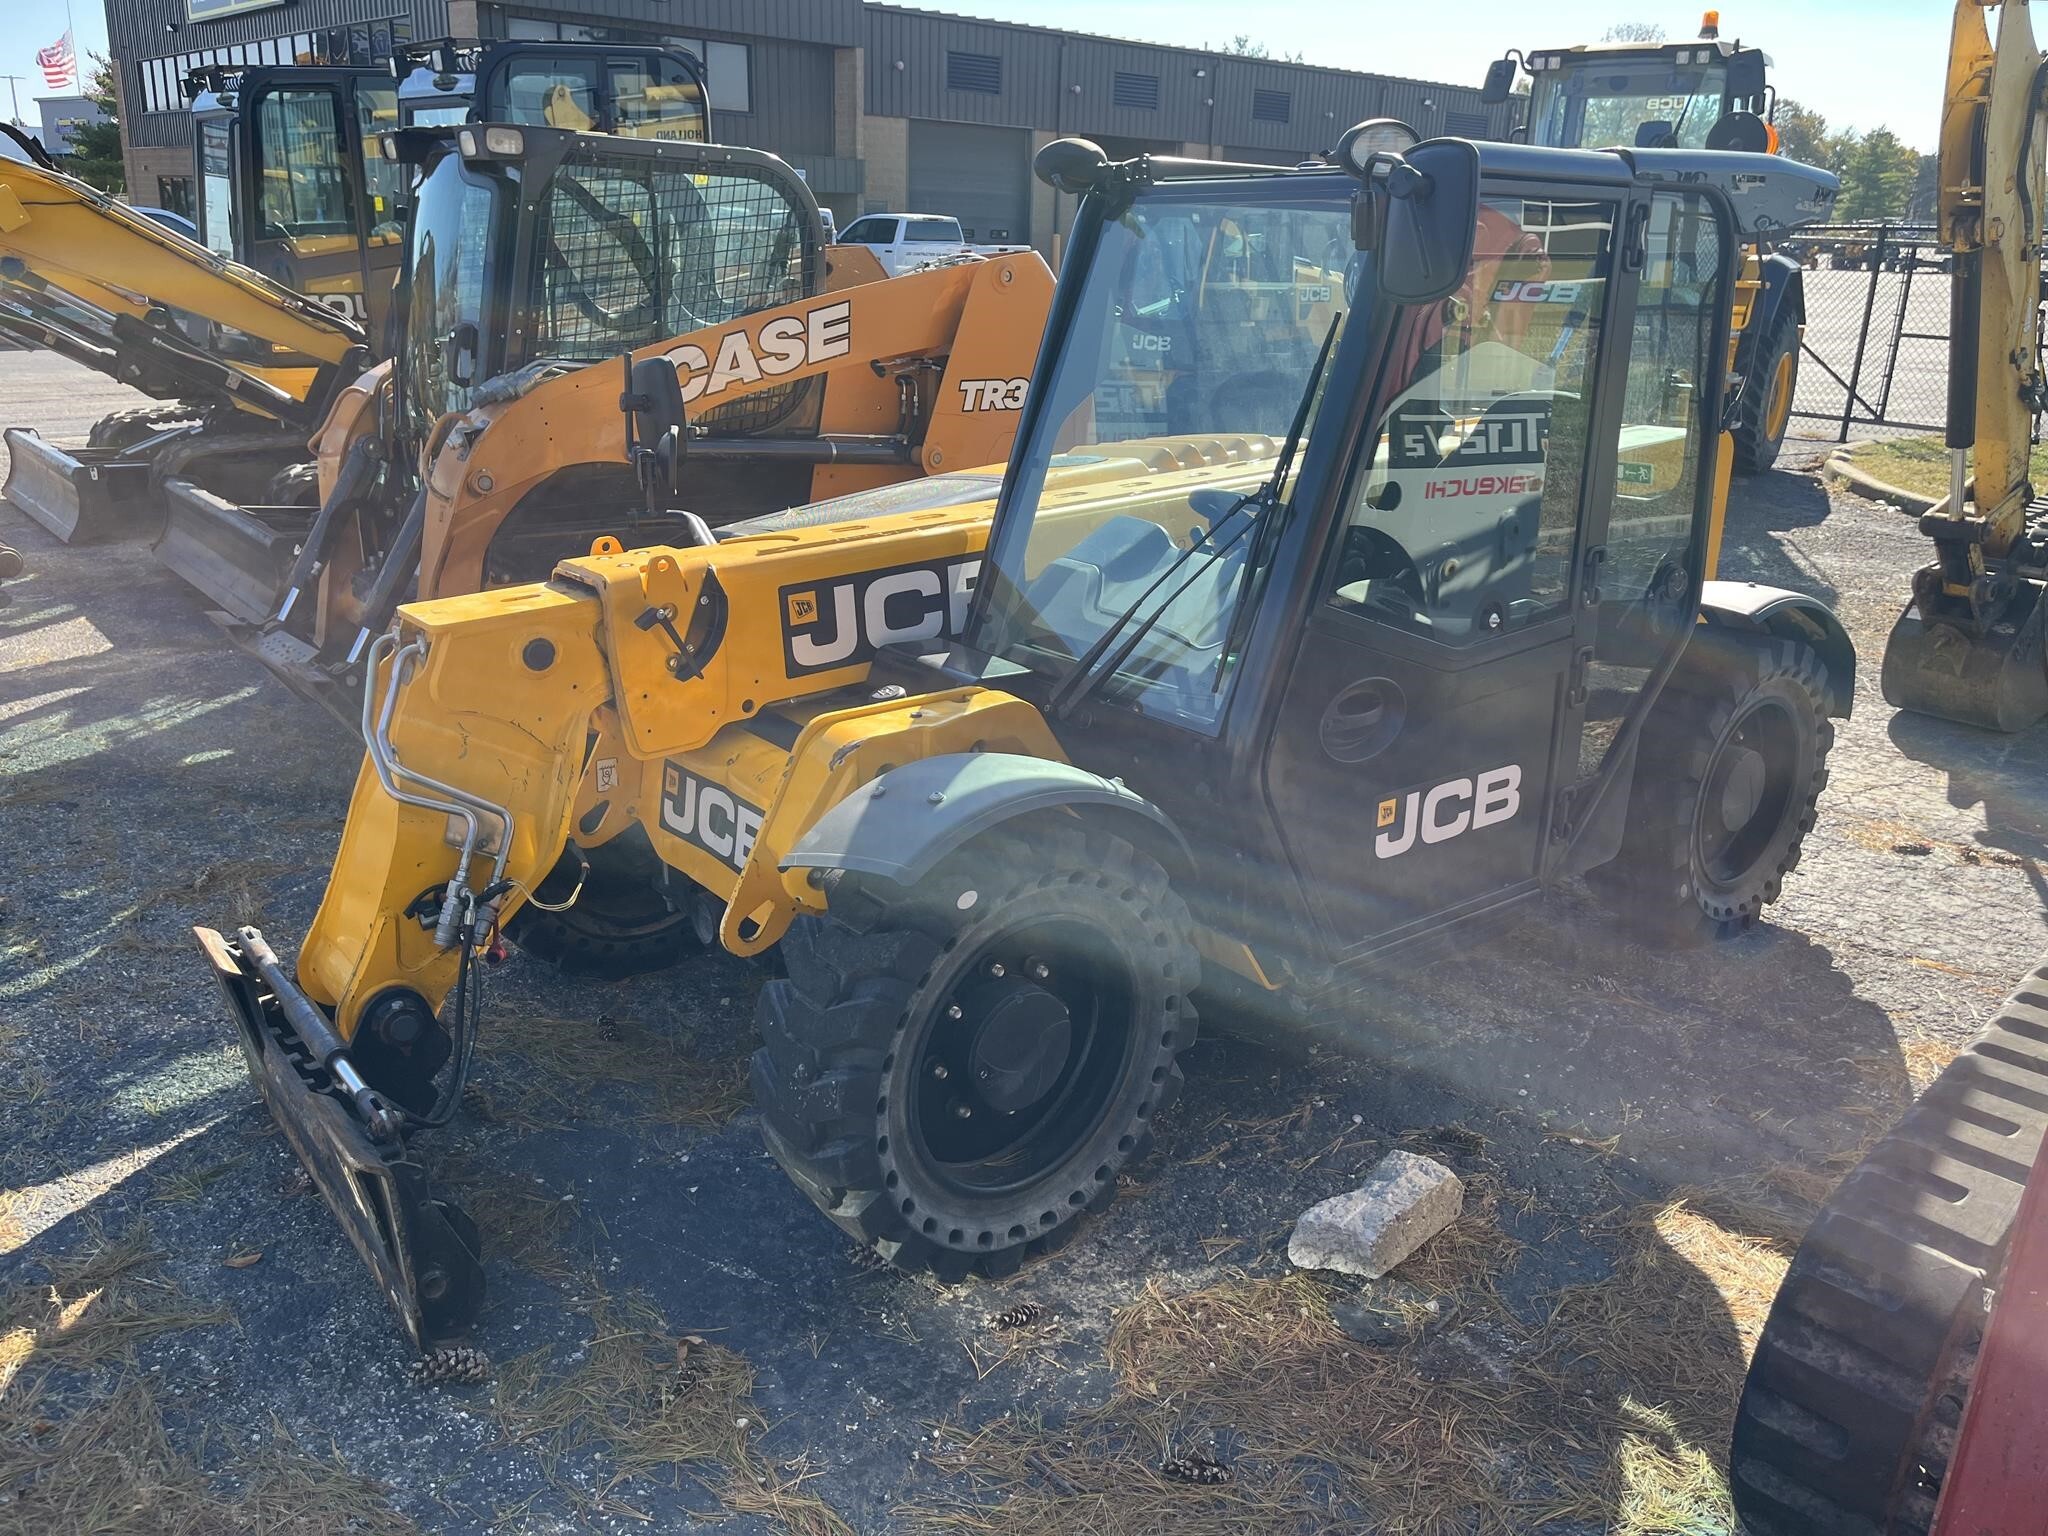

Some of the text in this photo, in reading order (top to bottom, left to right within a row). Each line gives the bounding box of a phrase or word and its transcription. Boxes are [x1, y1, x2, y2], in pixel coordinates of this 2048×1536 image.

[1300, 286, 1330, 302] JCB
[1493, 281, 1582, 302] JCB
[664, 300, 851, 404] CASE
[1132, 335, 1171, 351] JCB
[1375, 764, 1522, 859] JCB
